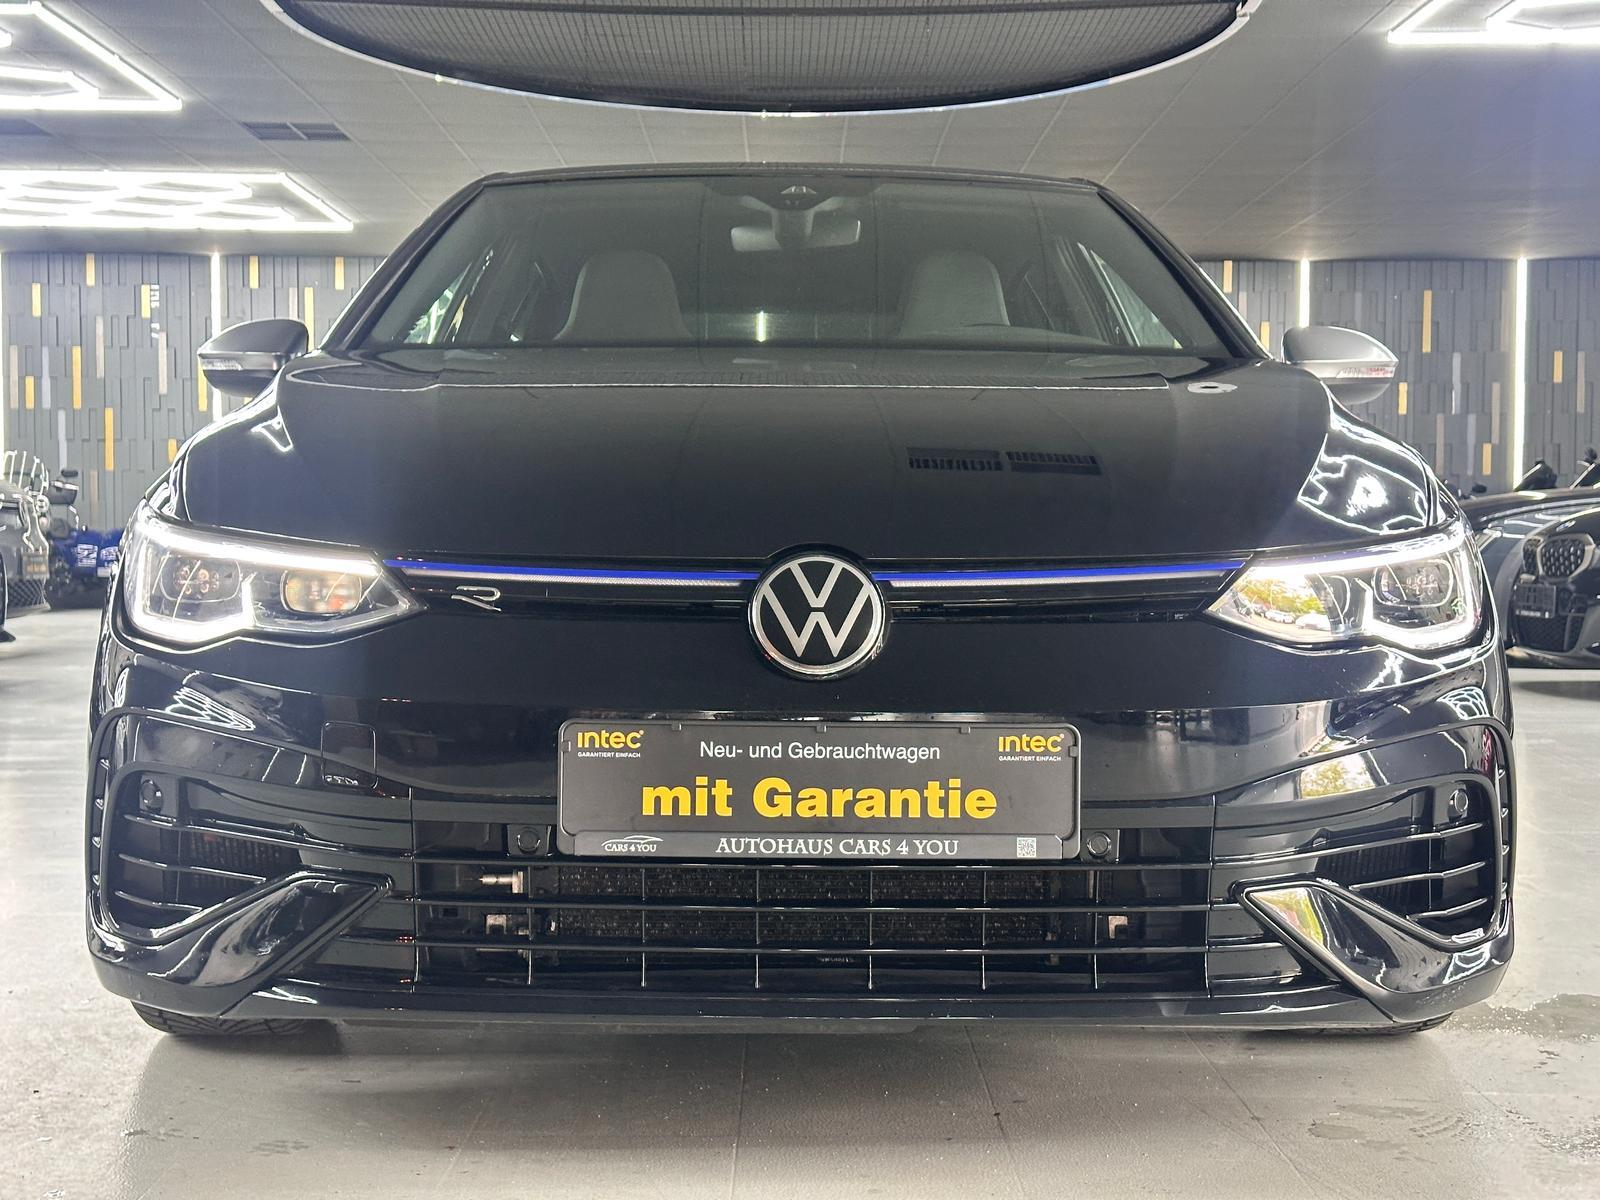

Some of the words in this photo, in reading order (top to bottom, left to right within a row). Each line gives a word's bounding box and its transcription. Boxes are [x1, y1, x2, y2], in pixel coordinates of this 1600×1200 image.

[699, 741, 743, 758] Neu-
[749, 742, 782, 759] und
[787, 742, 941, 763] Gebrauchtwagen
[641, 776, 733, 817] mit
[752, 776, 998, 819] Garantie
[604, 843, 628, 852] CARS
[628, 844, 636, 852] 4
[636, 844, 657, 852] YOU
[715, 837, 833, 856] AUTOHAUS
[839, 838, 891, 856] CARS
[896, 839, 909, 855] 4
[913, 839, 960, 856] YOU
